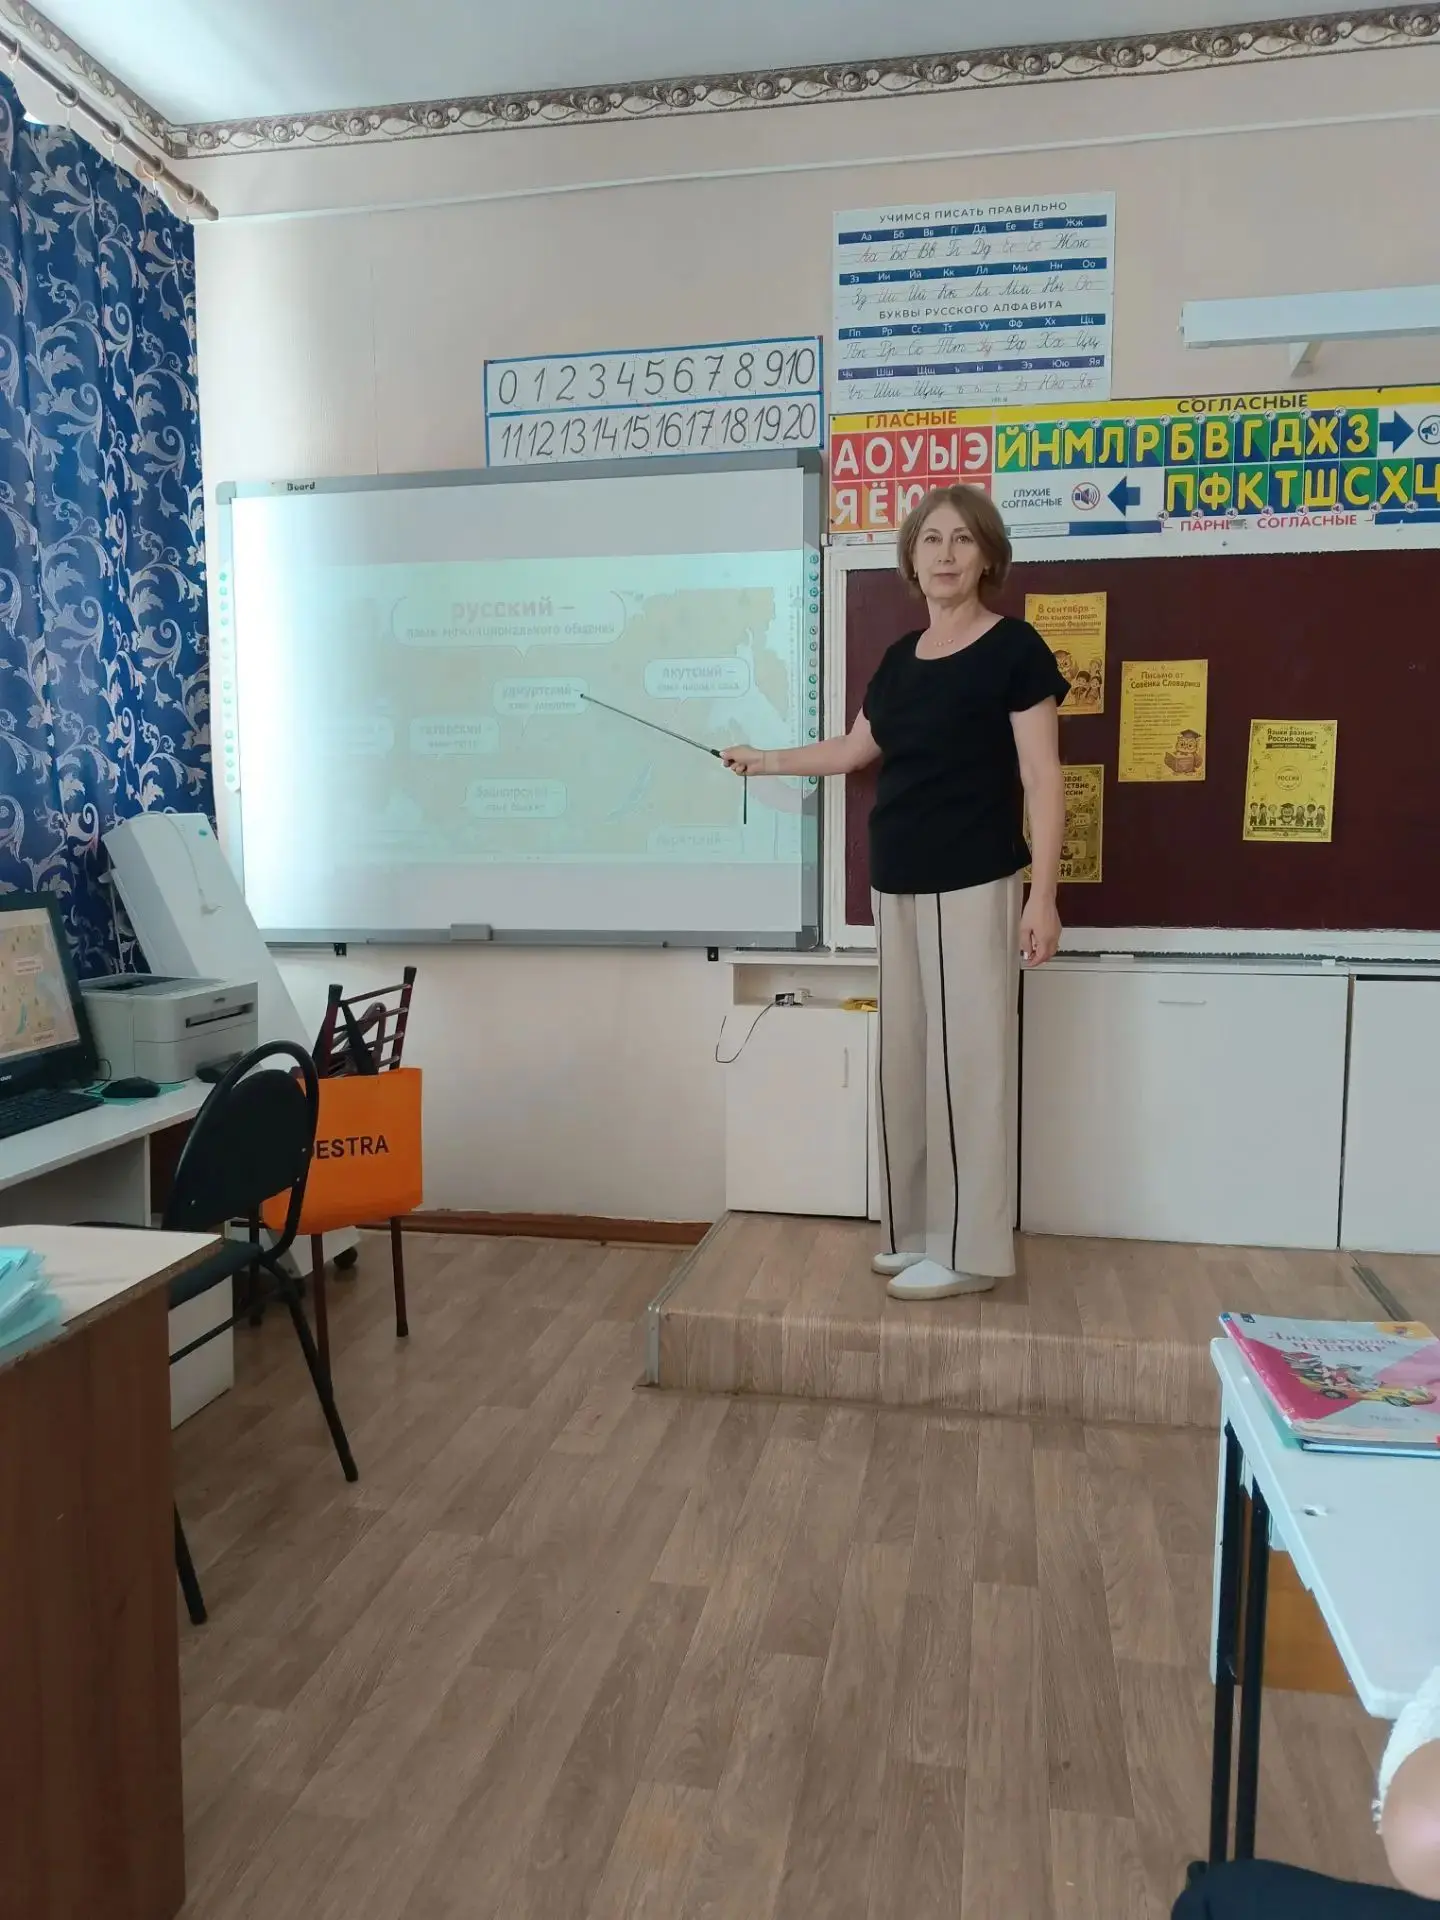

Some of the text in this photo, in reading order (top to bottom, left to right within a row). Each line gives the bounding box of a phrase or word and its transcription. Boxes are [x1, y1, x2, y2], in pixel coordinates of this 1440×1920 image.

[880, 202, 1067, 223] УЧИМСЯ ПИСАТЬ ПРАВИЛЬНО
[861, 233, 872, 241] Аа
[893, 230, 905, 239] Бб
[923, 228, 934, 237] Вв
[972, 225, 987, 233] Дд
[1005, 222, 1017, 231] Ее
[1065, 218, 1083, 227] Жж
[850, 259, 1096, 283] Зз Ии Йй Кк Лл Мм Нн Оо
[879, 300, 1063, 319] БУКВЫ РУССКОГО АЛФАВИТА
[849, 316, 1094, 337] Пп Рр Сс Тт Уу Фф Хх Цц
[500, 348, 815, 404] 0 1 2 3 4 5 6 7 8 9 10
[1177, 394, 1308, 413] СОГЛАСНЫЕ
[866, 410, 957, 429] ГЛАСНЫЕ
[501, 403, 815, 458] 11 12 13 14 15 16 17 18 19 20
[1001, 497, 1063, 509] СОГЛАСНЫЕ
[1013, 487, 1050, 498] ГЛУХИЕ
[1181, 514, 1357, 531] ПАРН СОГЛАСНЫЕ
[452, 596, 553, 623] русский
[1141, 671, 1172, 680] Письмо
[315, 1134, 390, 1160] ESTRA
